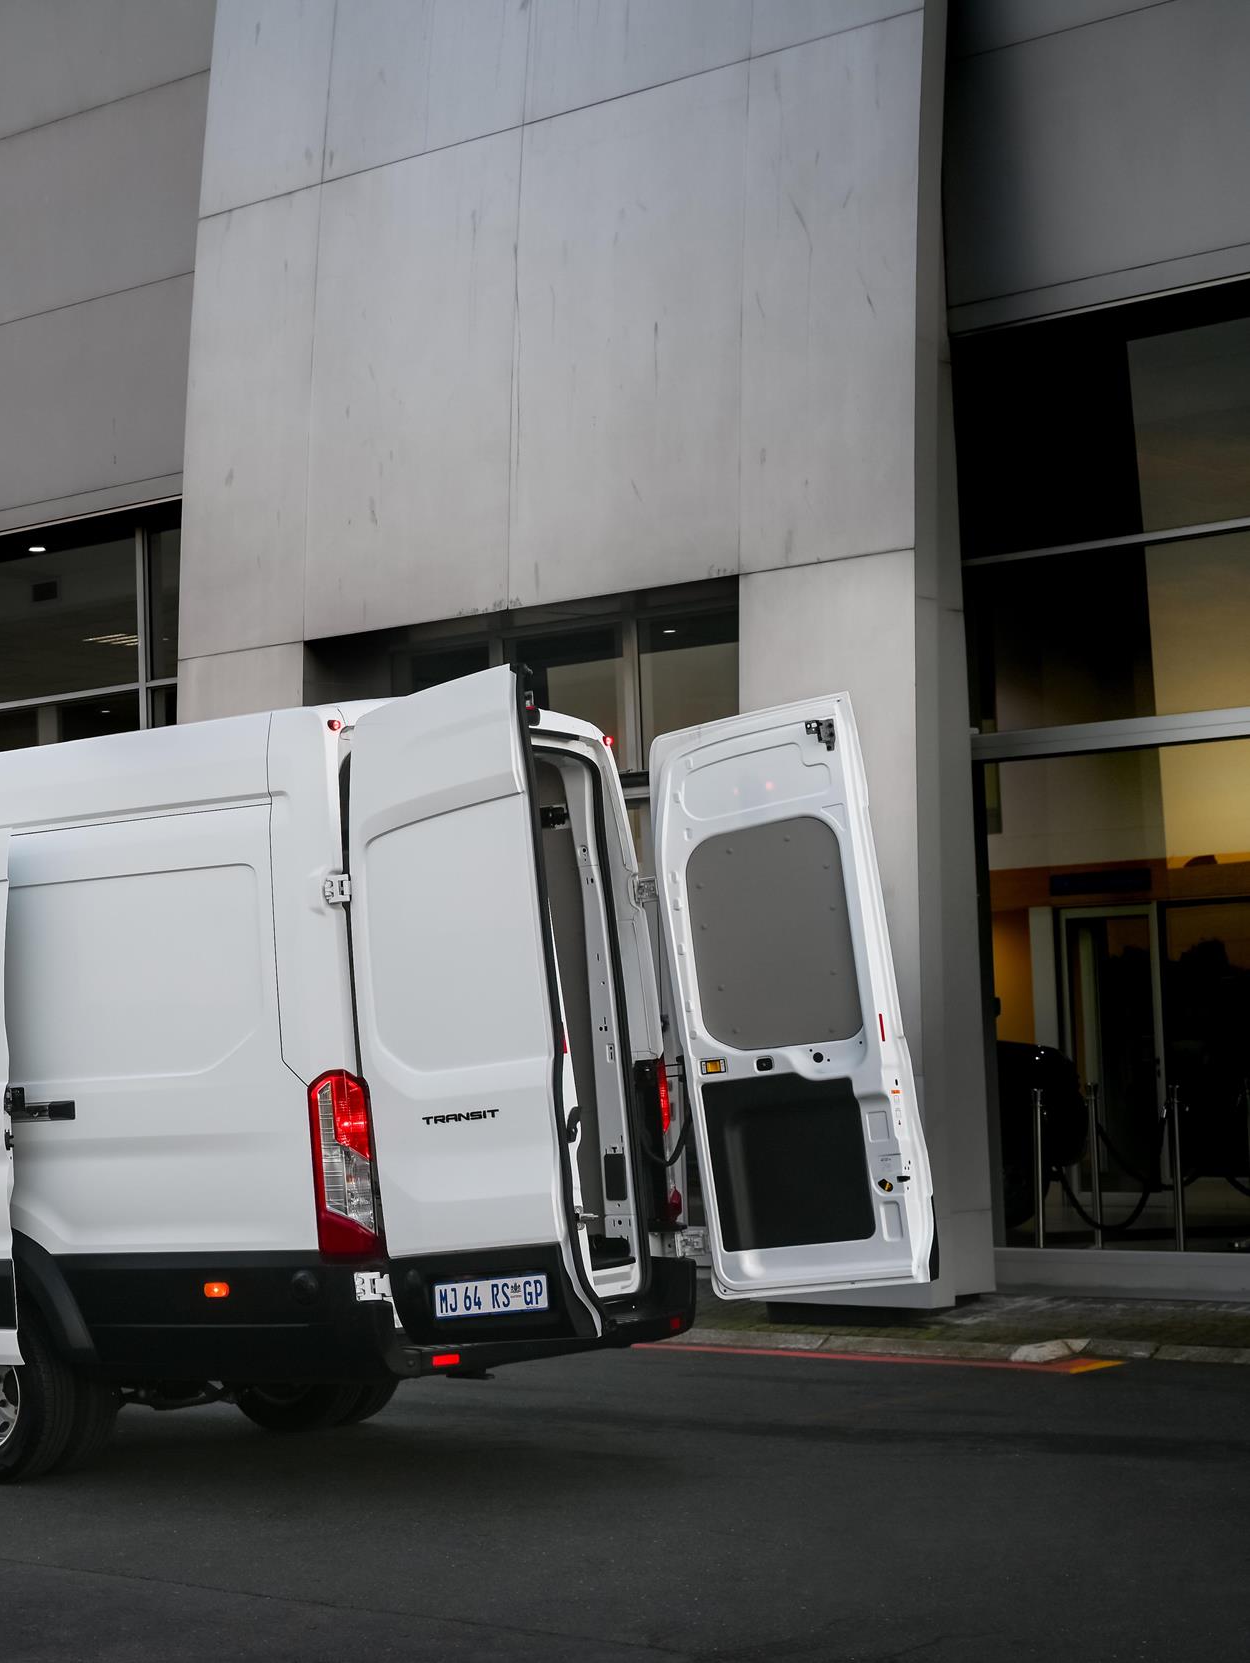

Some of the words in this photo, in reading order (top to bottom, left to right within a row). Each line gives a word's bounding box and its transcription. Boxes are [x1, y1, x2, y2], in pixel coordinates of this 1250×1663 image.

[421, 1109, 500, 1126] TRANSIT
[491, 1282, 510, 1309] RS
[523, 1279, 543, 1306] GP
